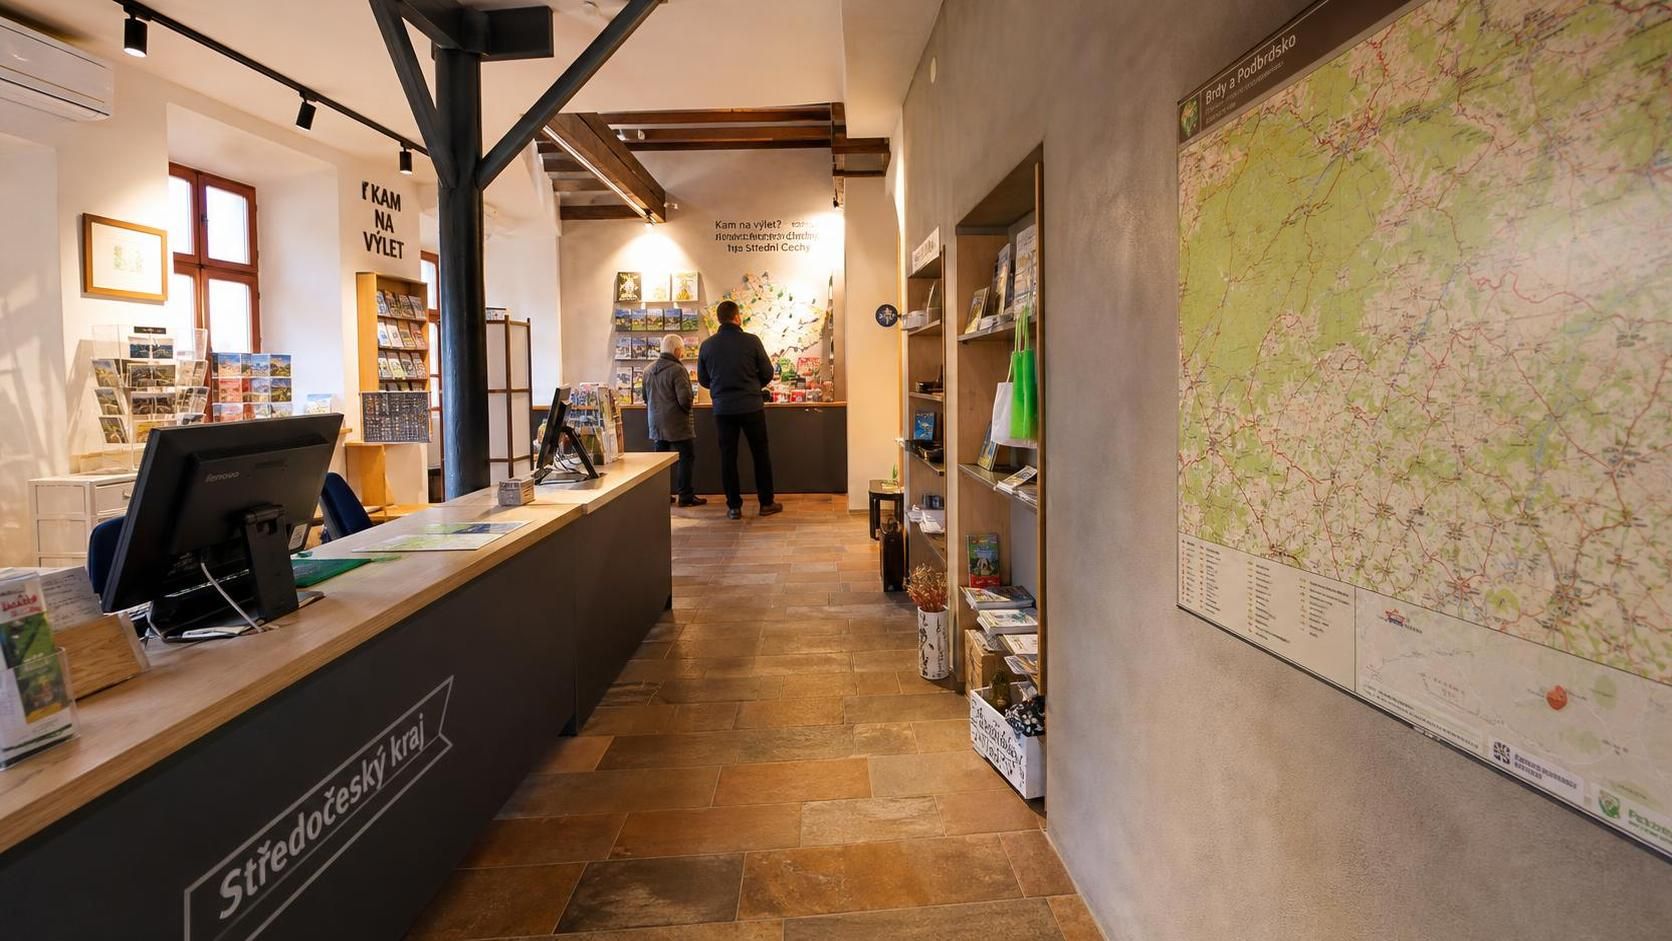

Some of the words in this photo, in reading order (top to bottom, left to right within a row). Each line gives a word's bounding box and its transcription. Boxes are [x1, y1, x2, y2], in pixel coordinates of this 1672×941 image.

[1205, 82, 1228, 105] Brdy
[1229, 77, 1236, 89] a
[1237, 34, 1297, 83] Podbrdsko
[371, 183, 401, 212] KAM
[375, 208, 395, 234] NA
[715, 220, 737, 229] Kam
[753, 219, 782, 231] výlet?
[363, 230, 405, 259] VÝLET
[219, 745, 387, 920] Středočeský
[391, 712, 425, 767] kraj
